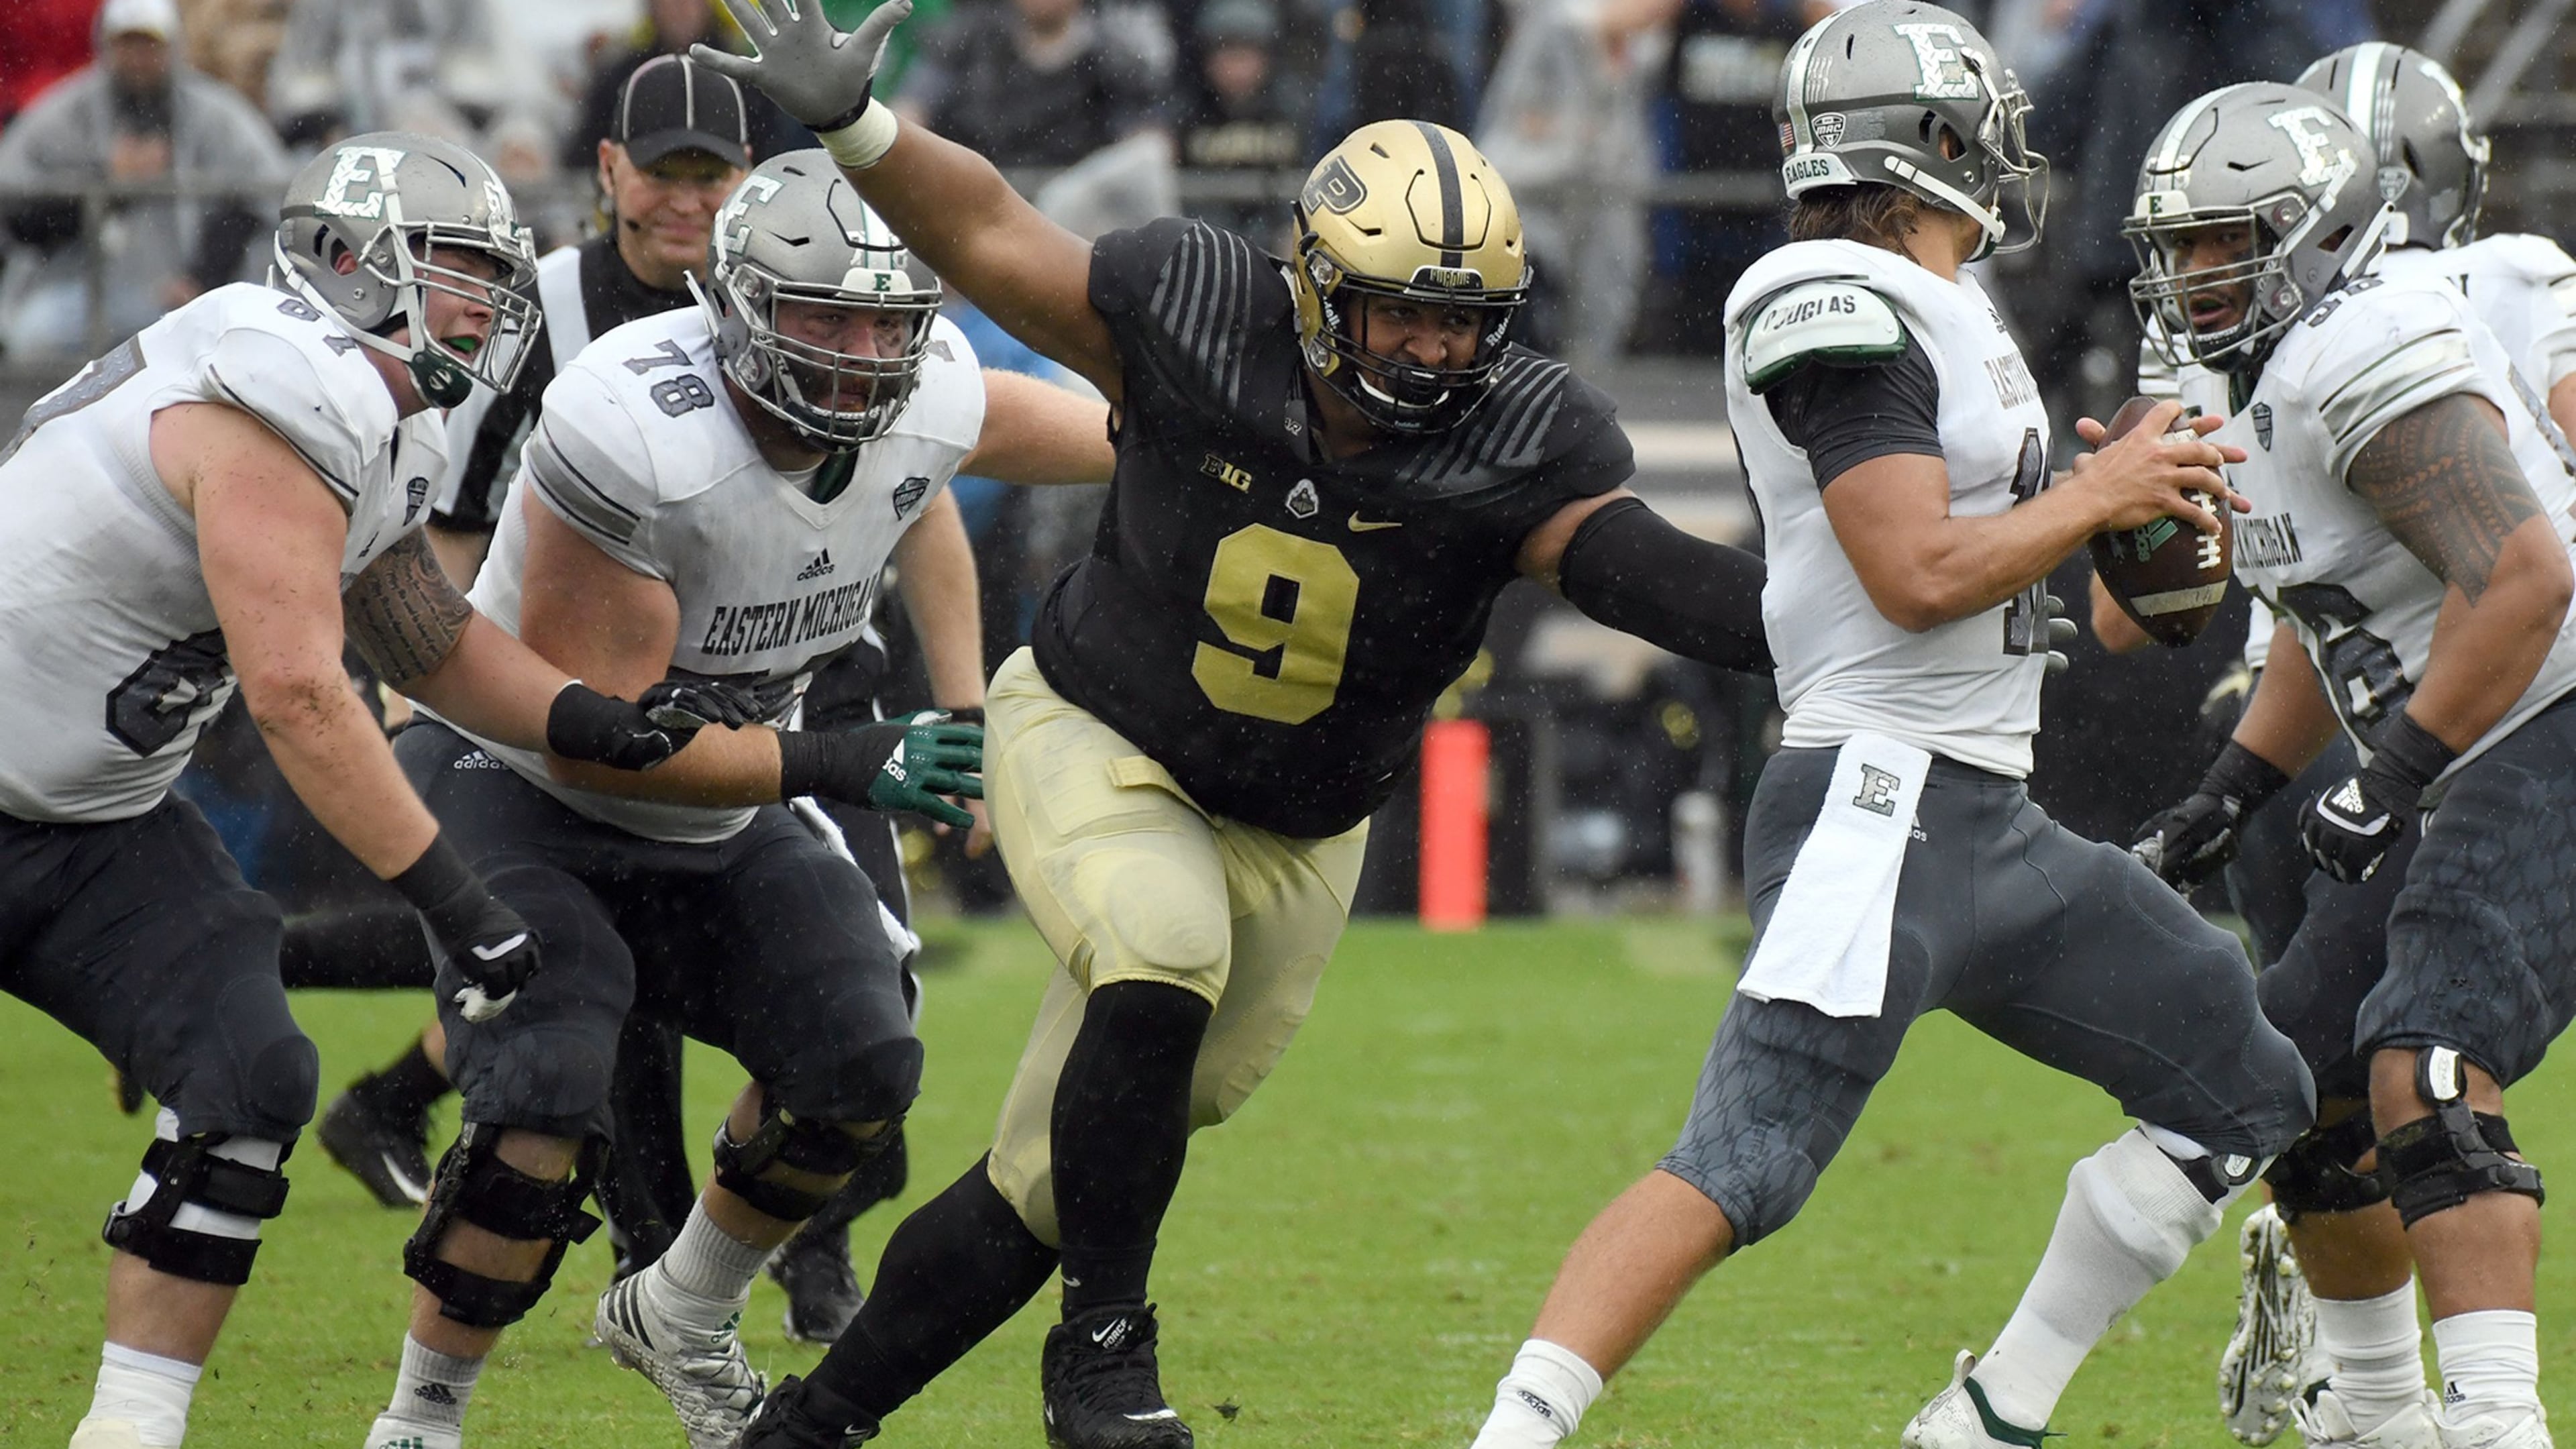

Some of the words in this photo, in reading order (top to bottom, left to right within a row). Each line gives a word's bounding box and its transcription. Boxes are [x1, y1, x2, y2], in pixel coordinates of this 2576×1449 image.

[1892, 23, 1980, 101] E
[1786, 158, 1830, 184] EAGLES
[2267, 106, 2356, 188] E
[313, 146, 405, 220] E
[1303, 155, 1368, 215] P
[2149, 196, 2163, 213] E
[711, 174, 786, 258] E
[873, 274, 891, 291] E
[622, 338, 715, 418] 78
[1200, 453, 1252, 492] BIG
[797, 564, 835, 581] adidas
[701, 599, 801, 655] EASTERN
[1191, 523, 1360, 725] 9
[1852, 763, 1900, 817] E
[1102, 1319, 1126, 1349] FORCE
[414, 1387, 458, 1405] adidas
[1517, 1391, 1552, 1417] adidas
